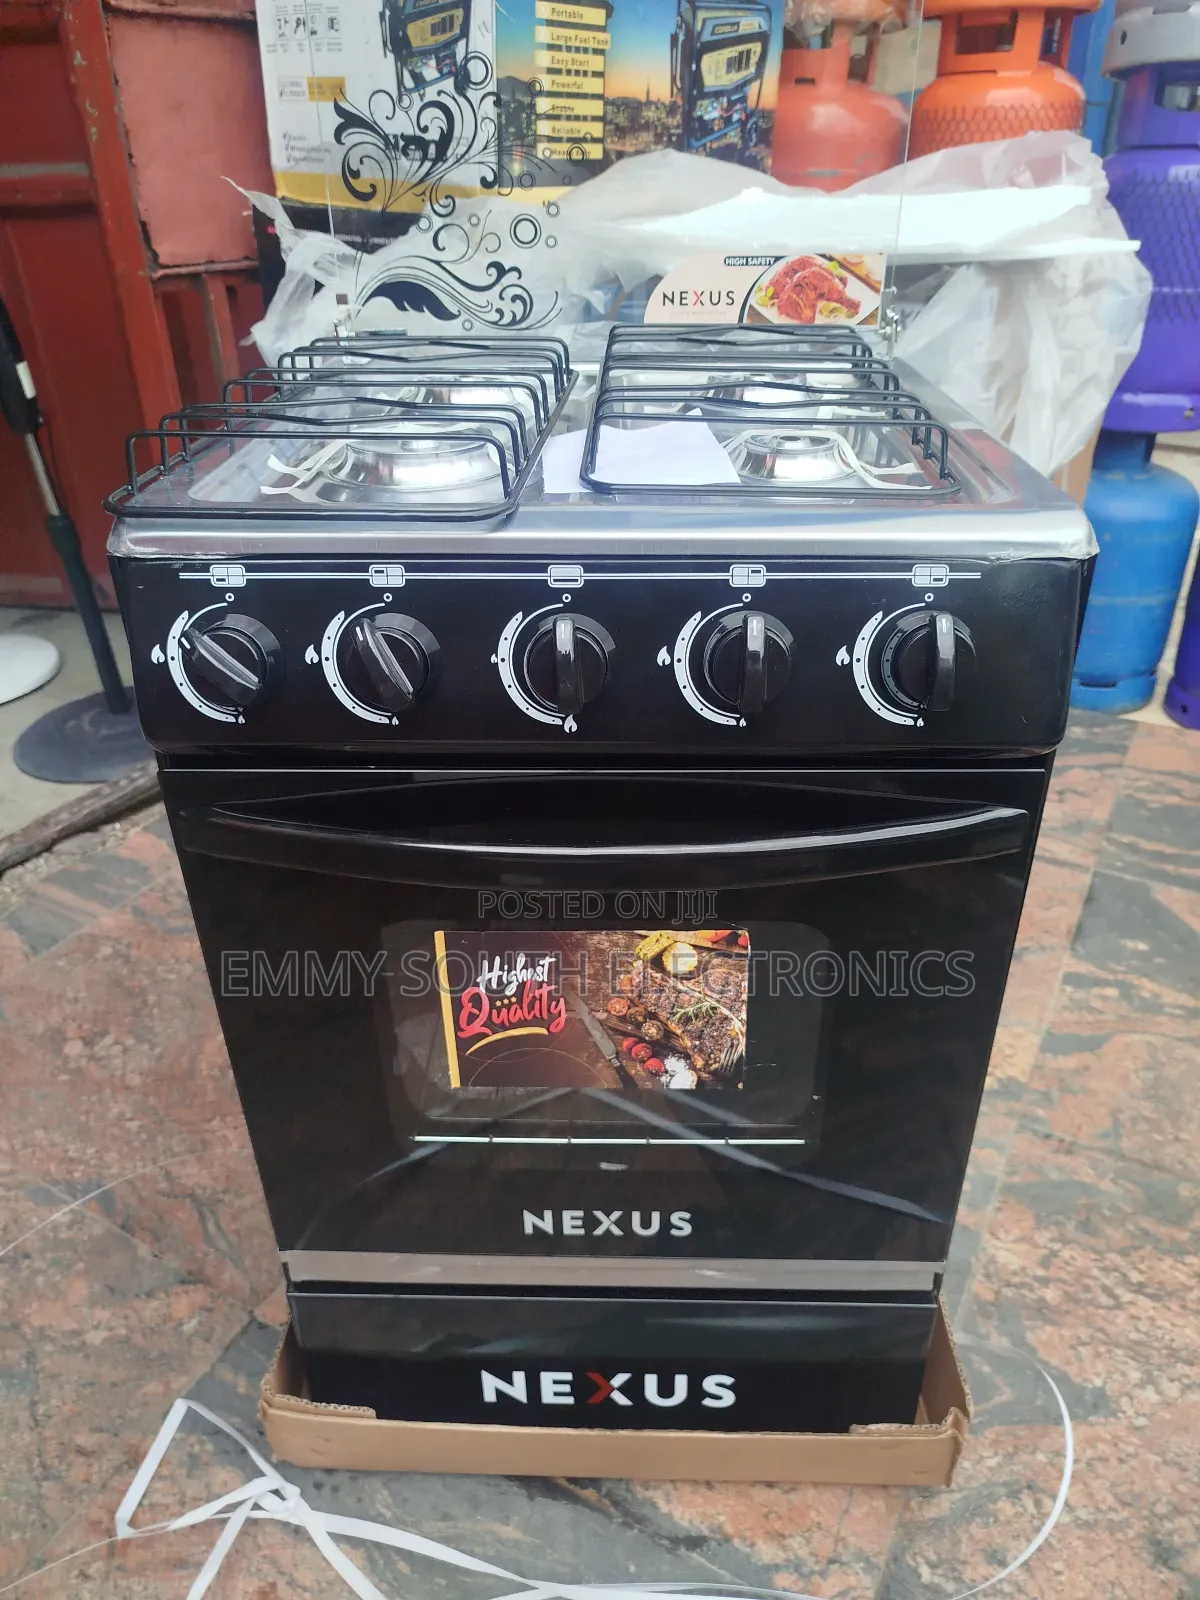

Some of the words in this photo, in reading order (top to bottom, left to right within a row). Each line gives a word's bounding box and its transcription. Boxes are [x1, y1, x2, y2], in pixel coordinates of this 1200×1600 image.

[551, 7, 584, 20] Portable
[551, 32, 573, 44] Large
[574, 34, 591, 43] Fuel
[551, 55, 569, 68] Easy
[570, 57, 590, 68] Start
[551, 79, 584, 91] Powerful
[725, 257, 747, 266] HIGH
[747, 257, 775, 266] SAFETY
[662, 290, 735, 306] NEXUS
[476, 952, 557, 995] Highest
[457, 979, 568, 1039] Quality
[522, 1208, 694, 1237] NEXUS
[480, 1368, 737, 1409] NEXUS
